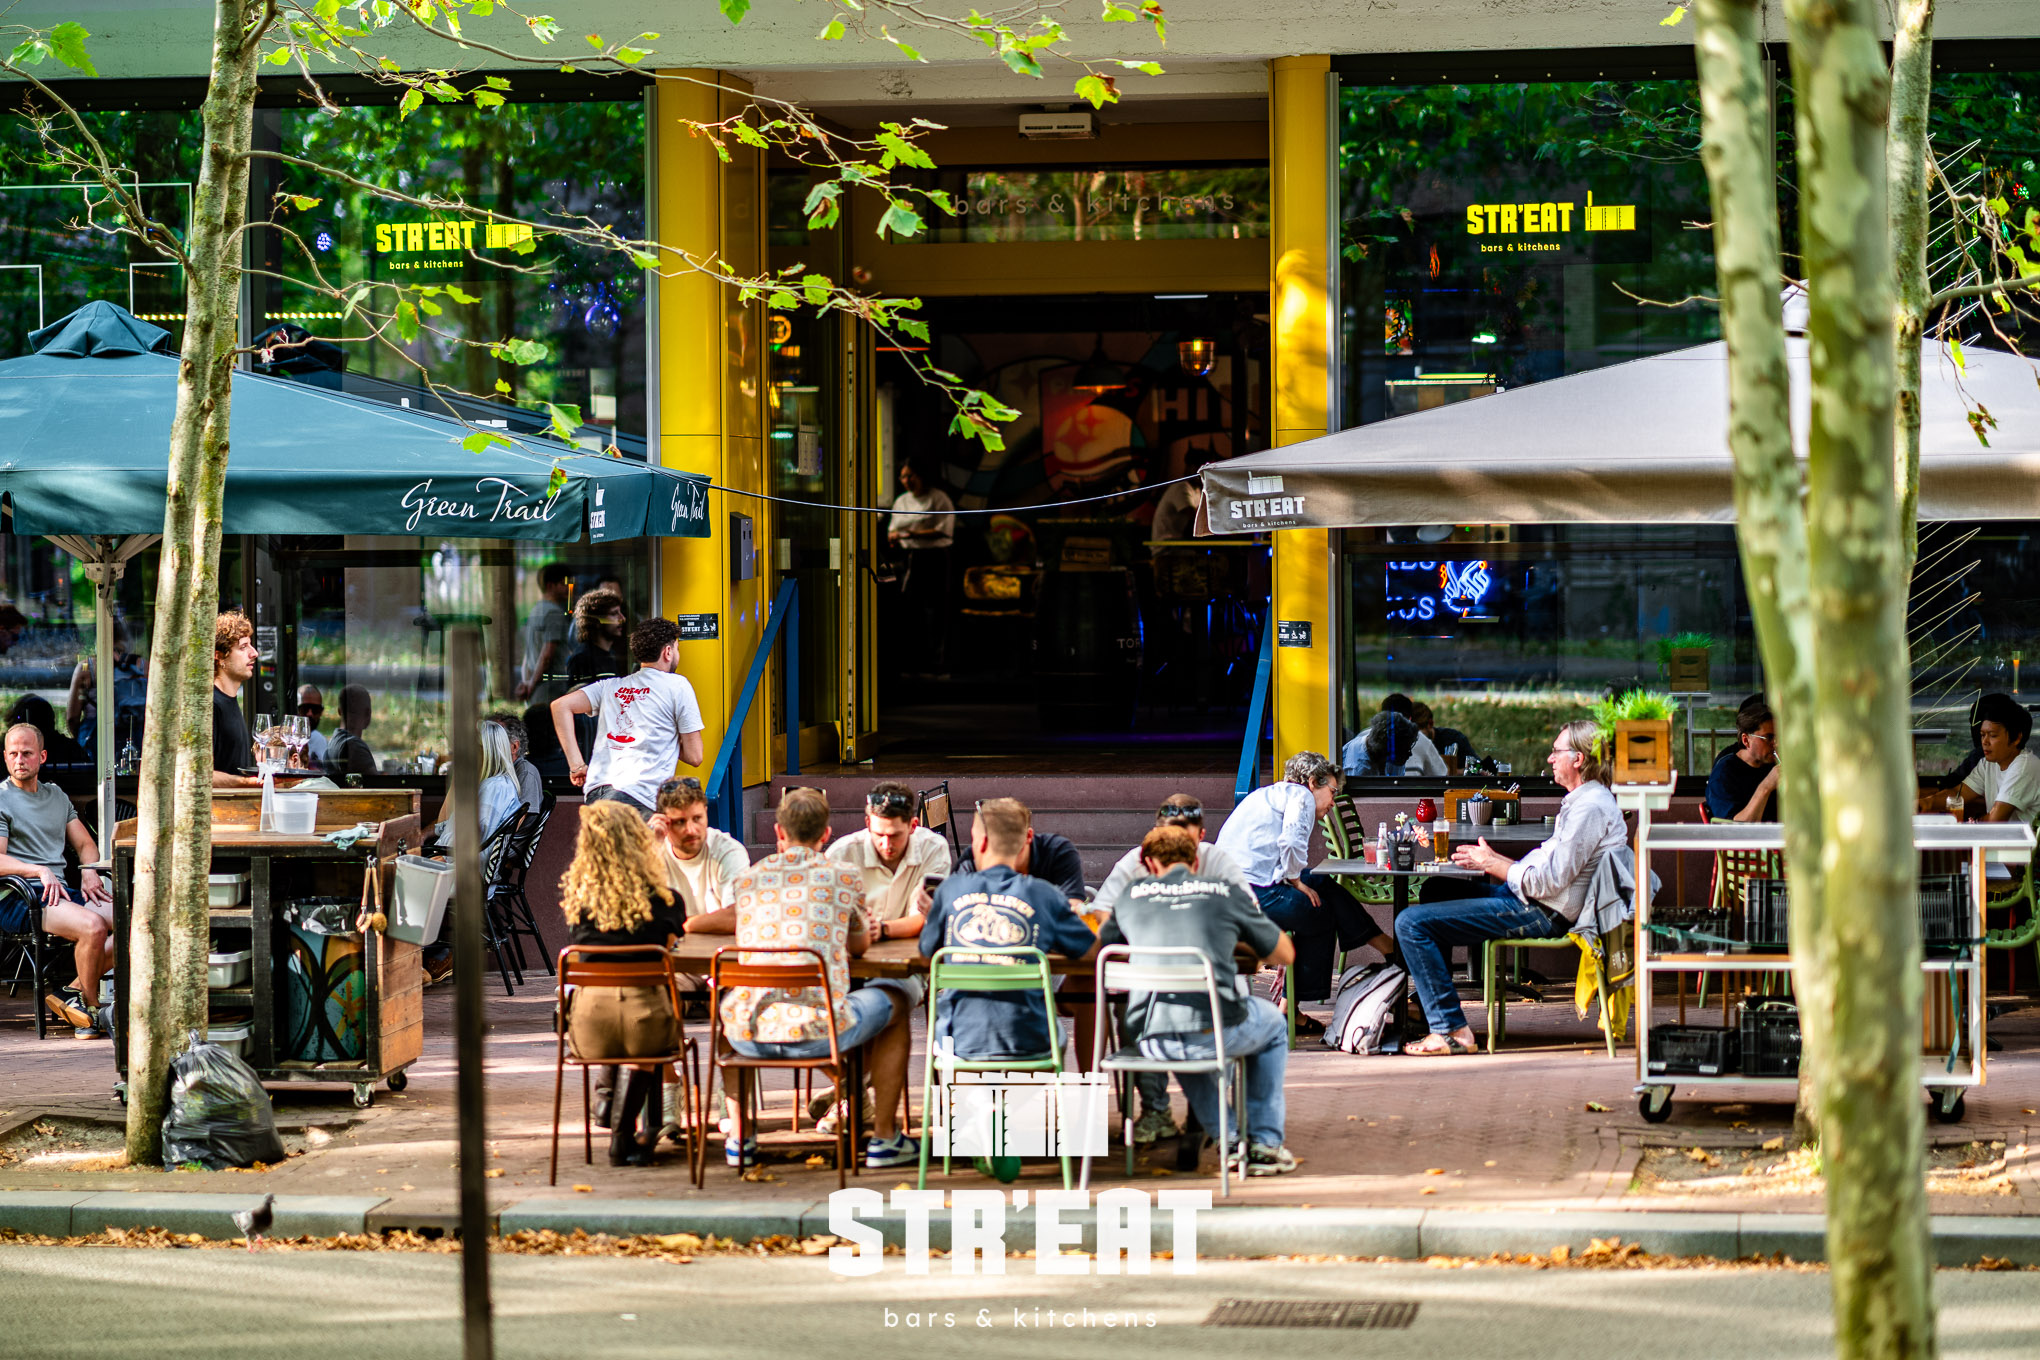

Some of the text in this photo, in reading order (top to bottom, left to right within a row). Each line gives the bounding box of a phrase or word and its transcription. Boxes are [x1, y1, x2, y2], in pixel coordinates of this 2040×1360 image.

[955, 191, 1235, 216] bars & kitchens
[1466, 202, 1575, 236] STR'EAT
[376, 221, 476, 252] STR'EAT
[1480, 242, 1561, 252] bars & kitchens
[389, 260, 464, 270] bars & kitchens
[401, 477, 562, 532] Green Trail
[671, 482, 689, 532] Green
[1230, 496, 1306, 519] STR'EAT
